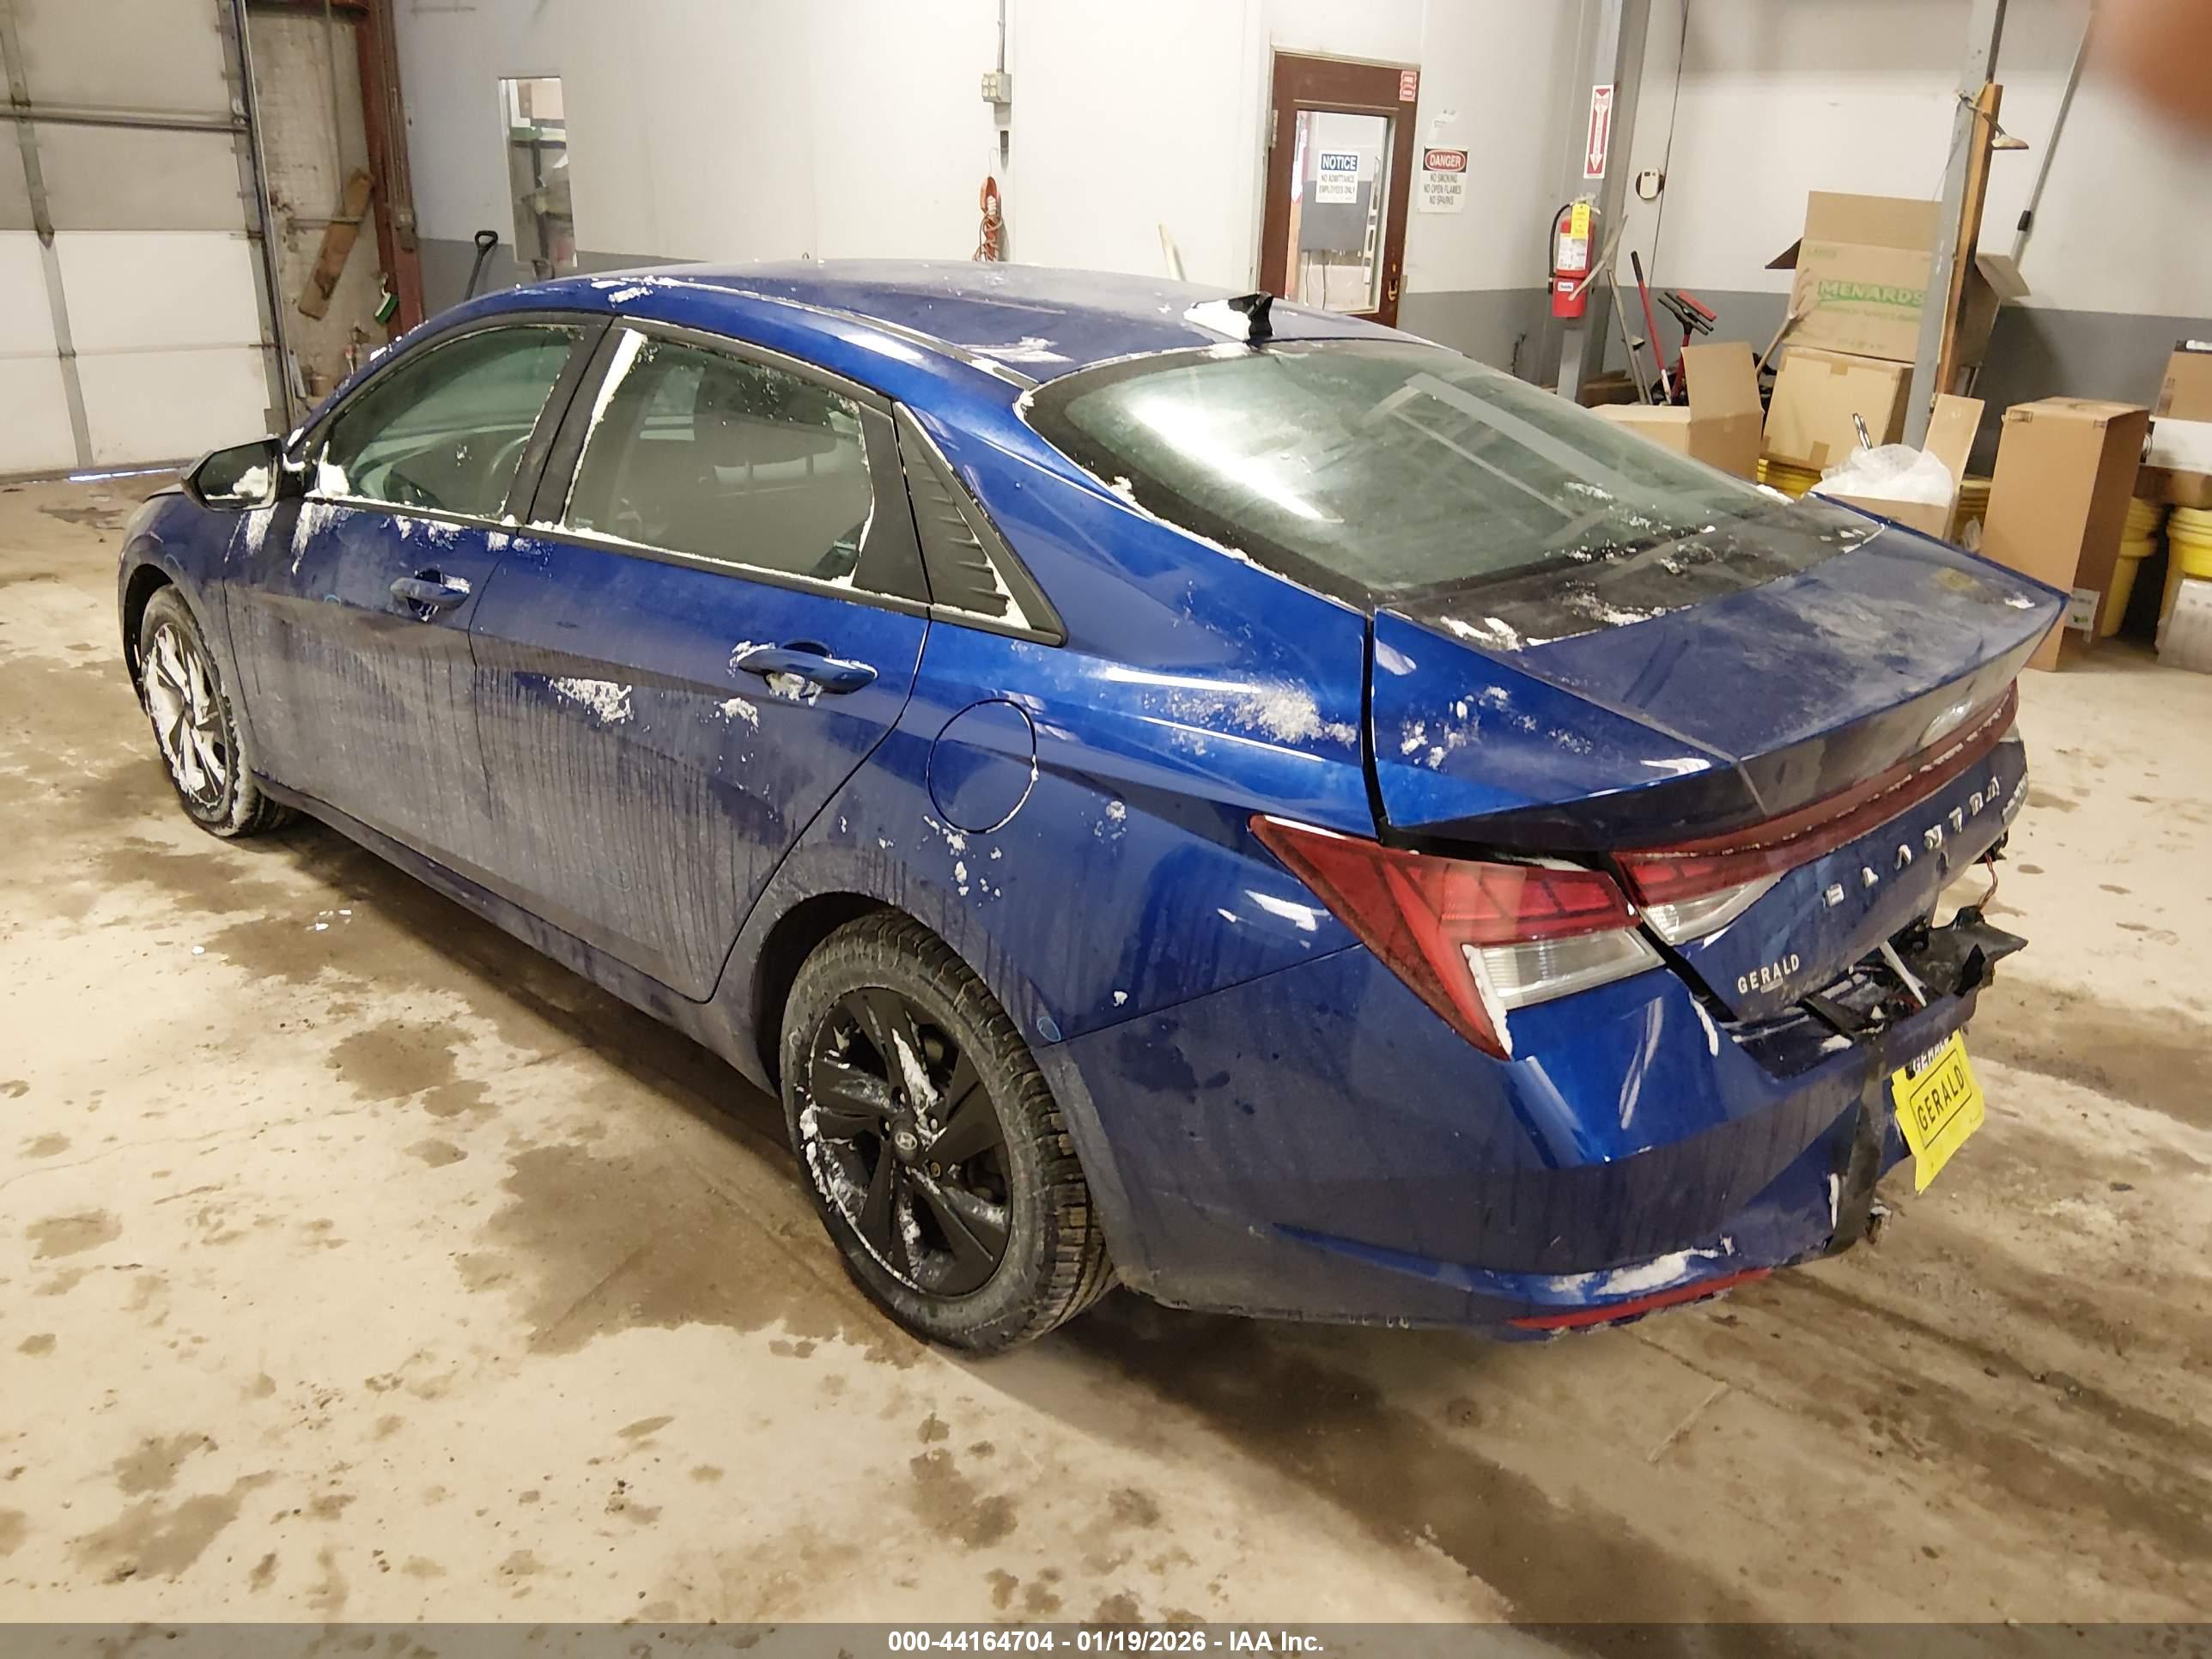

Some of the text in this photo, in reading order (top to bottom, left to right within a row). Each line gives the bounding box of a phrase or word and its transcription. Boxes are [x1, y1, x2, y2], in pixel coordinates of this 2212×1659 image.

[1322, 155, 1357, 170] NOTICE
[1429, 154, 1462, 167] DANGER
[1430, 173, 1458, 184] NO SMOKING
[1424, 184, 1462, 195] NO OPEN FLAMES
[1429, 195, 1455, 206] NO SPARKS
[1818, 280, 1925, 305] MENARDS
[1737, 954, 1800, 994] GERALD
[1917, 1064, 1965, 1132] GERALD
